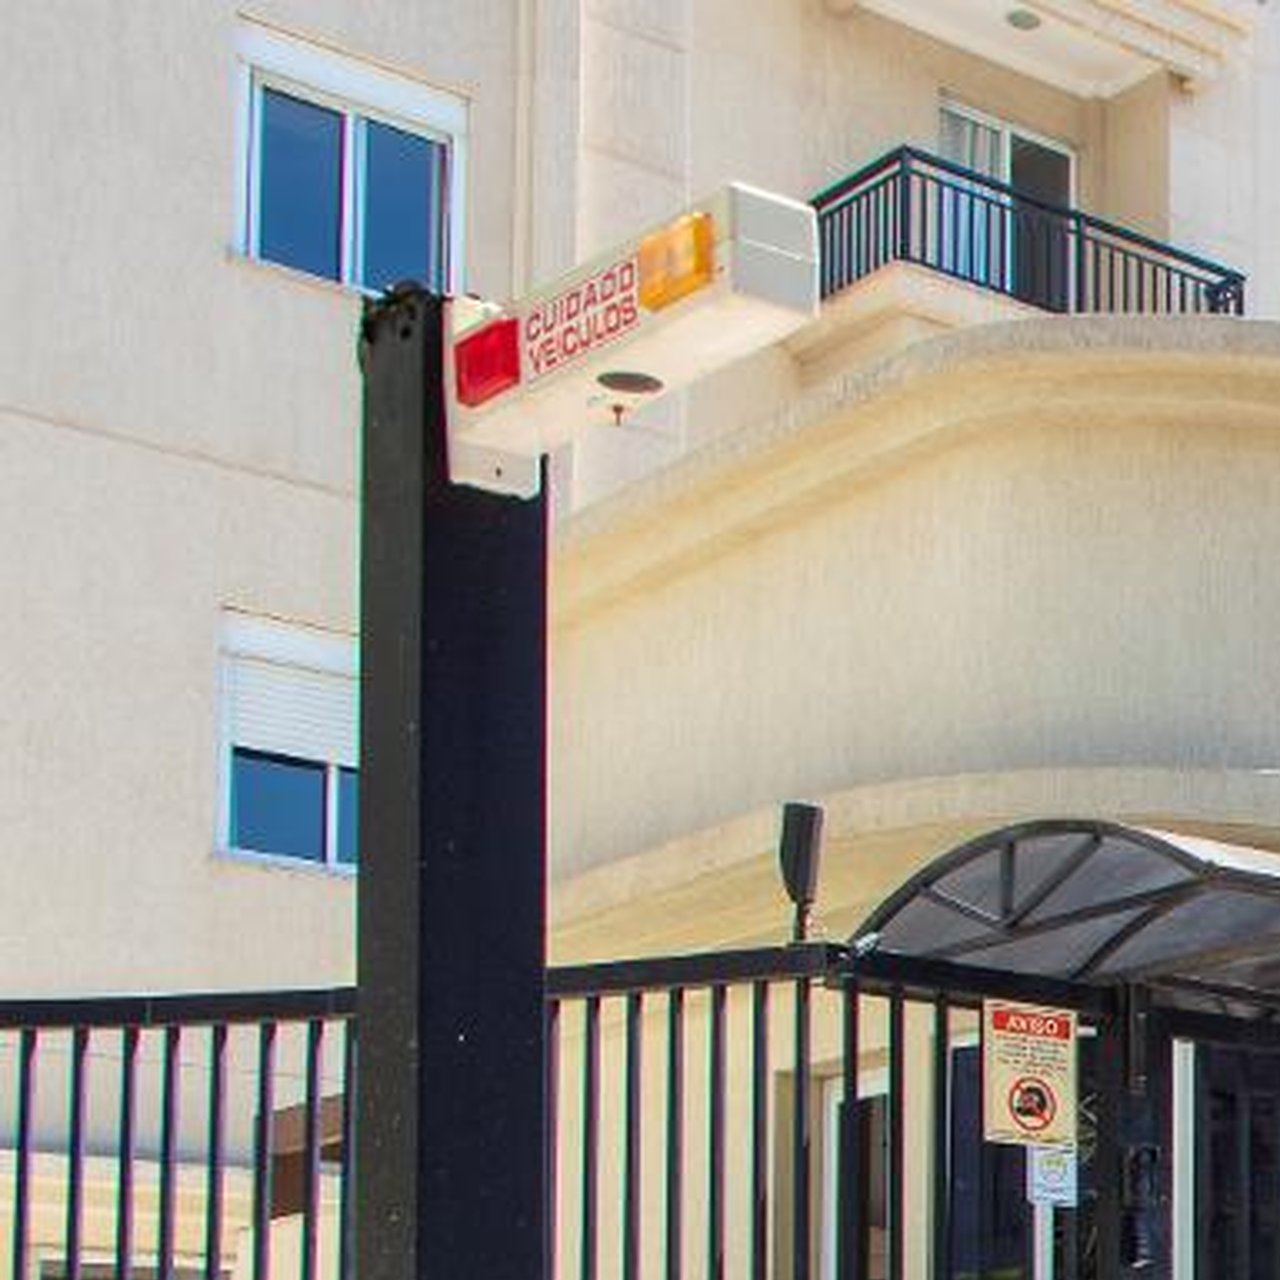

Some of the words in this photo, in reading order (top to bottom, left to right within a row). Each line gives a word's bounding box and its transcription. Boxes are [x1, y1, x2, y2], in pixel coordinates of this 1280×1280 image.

[525, 262, 634, 341] CUIDADO
[528, 294, 638, 373] VEICULOS
[1005, 1013, 1060, 1036] AVISO
